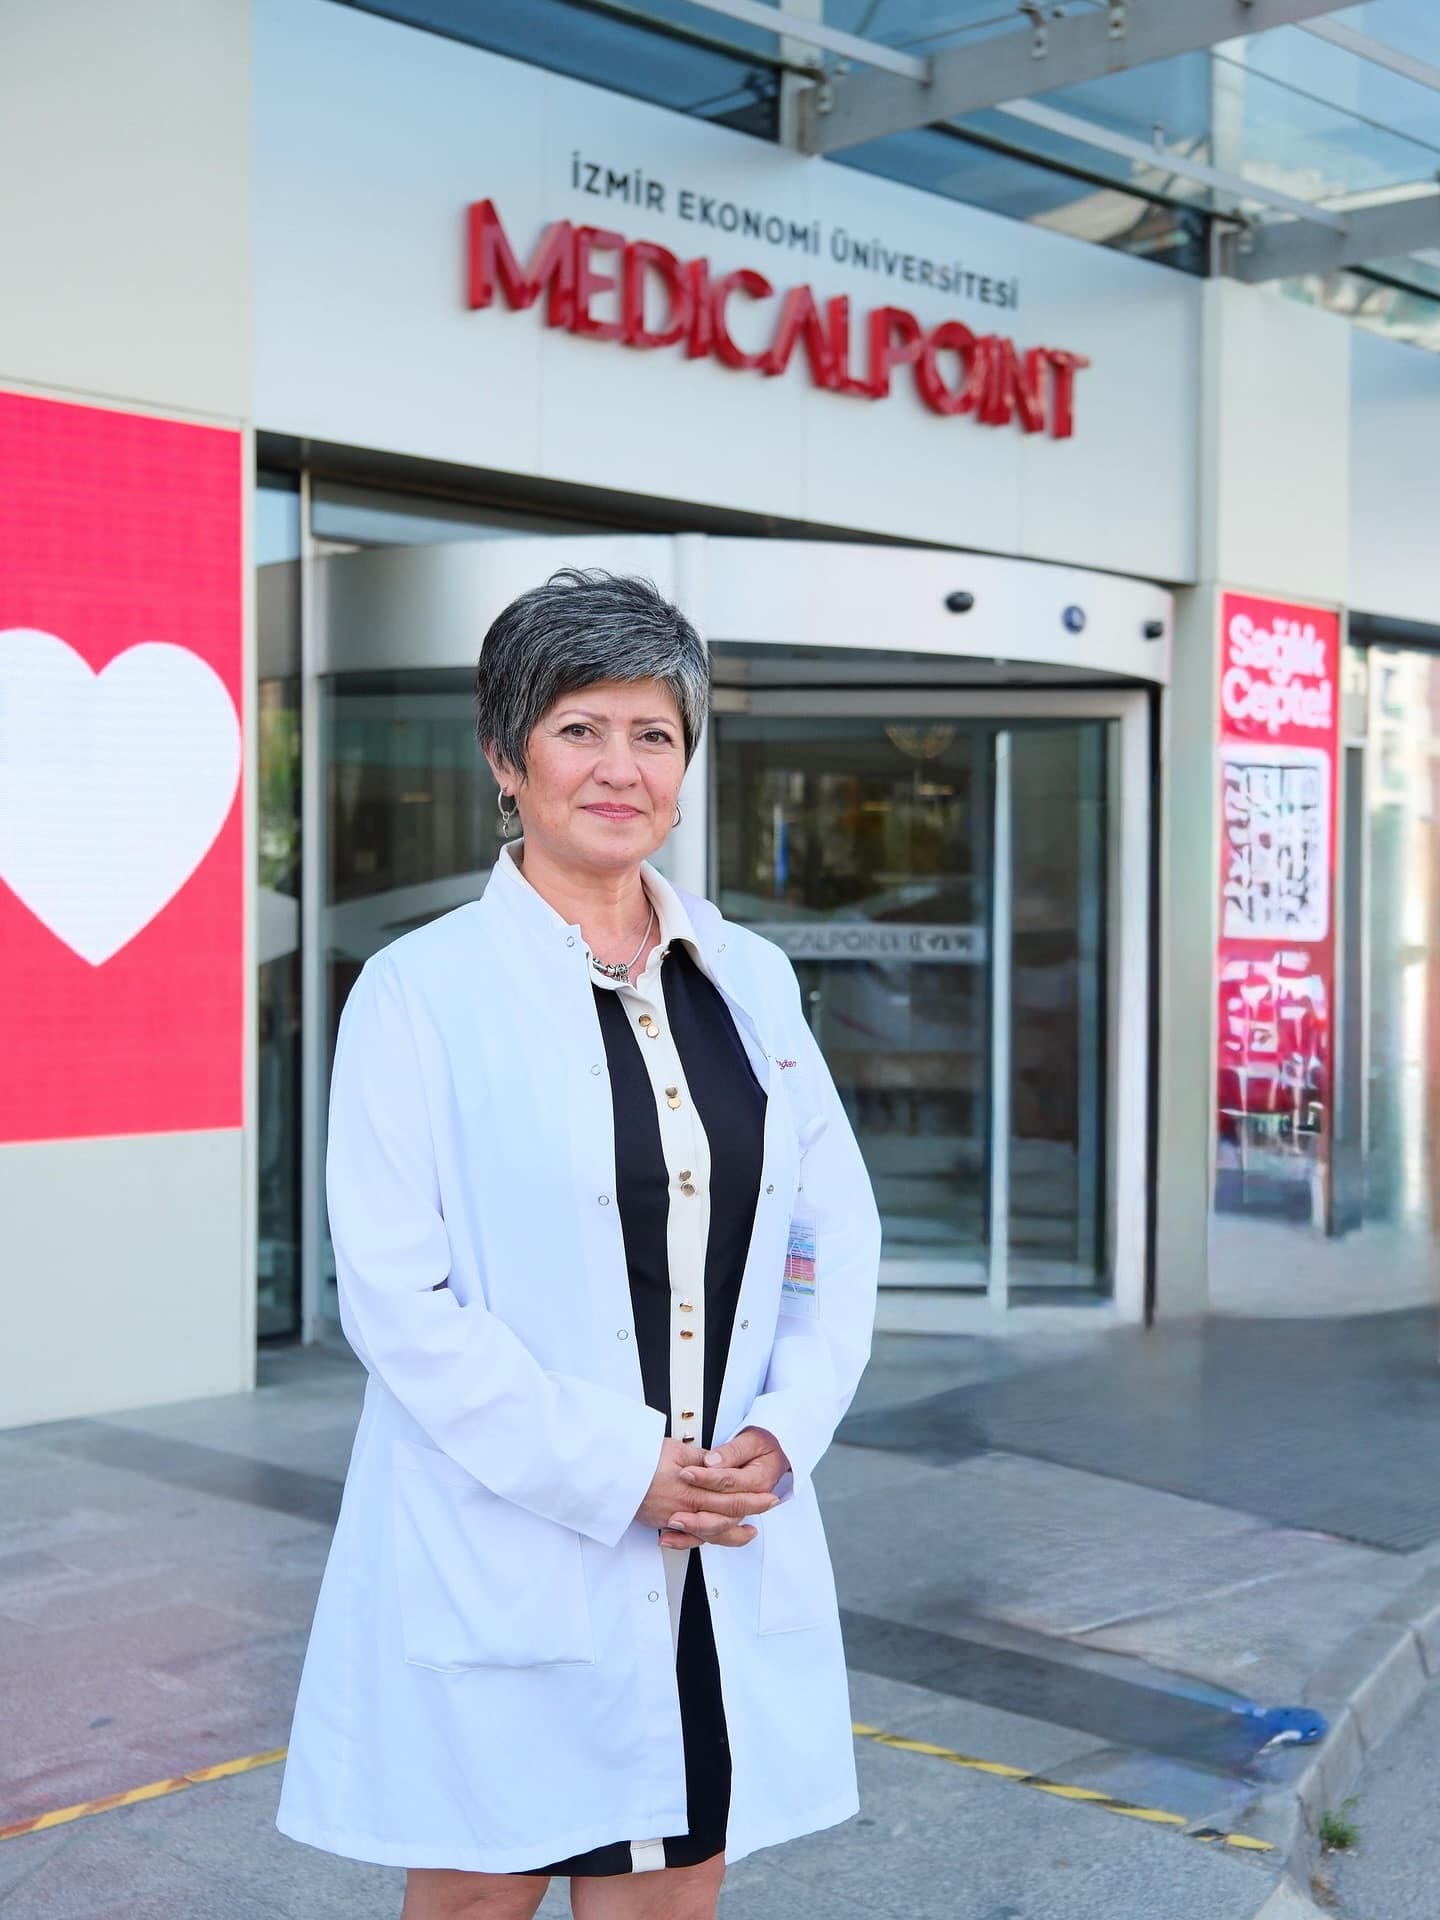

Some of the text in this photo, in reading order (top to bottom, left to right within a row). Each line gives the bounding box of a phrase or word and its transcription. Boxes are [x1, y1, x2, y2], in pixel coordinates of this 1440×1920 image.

[466, 197, 1089, 439] MEDICALPOINT
[571, 151, 1019, 309] İZMİR EKONOMİ ÜNİVERSİTESİ
